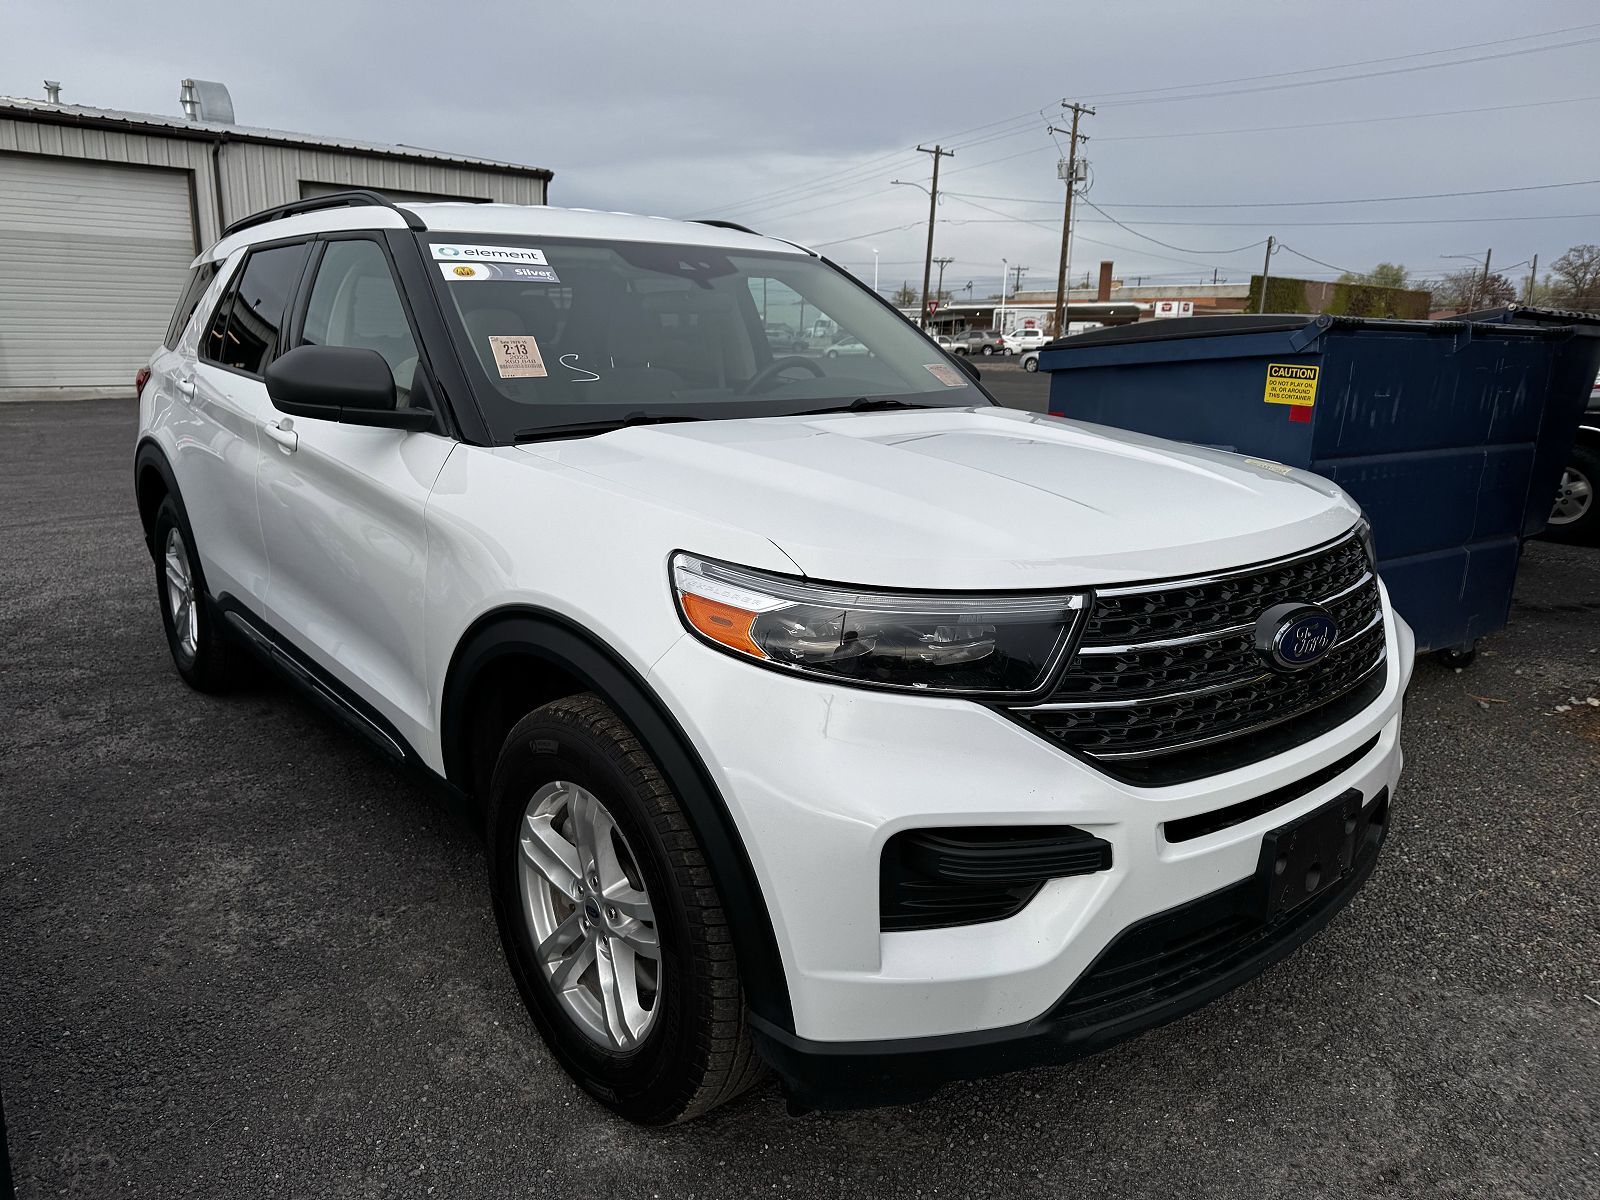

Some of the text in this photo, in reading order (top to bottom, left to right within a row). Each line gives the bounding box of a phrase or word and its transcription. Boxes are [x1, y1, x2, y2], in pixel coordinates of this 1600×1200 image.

[464, 248, 538, 260] element
[514, 268, 552, 277] Silver
[503, 344, 528, 355] 2:13
[1271, 366, 1315, 379] CAUTION
[1281, 393, 1312, 401] CONTAINER
[1293, 626, 1330, 657] Ford
